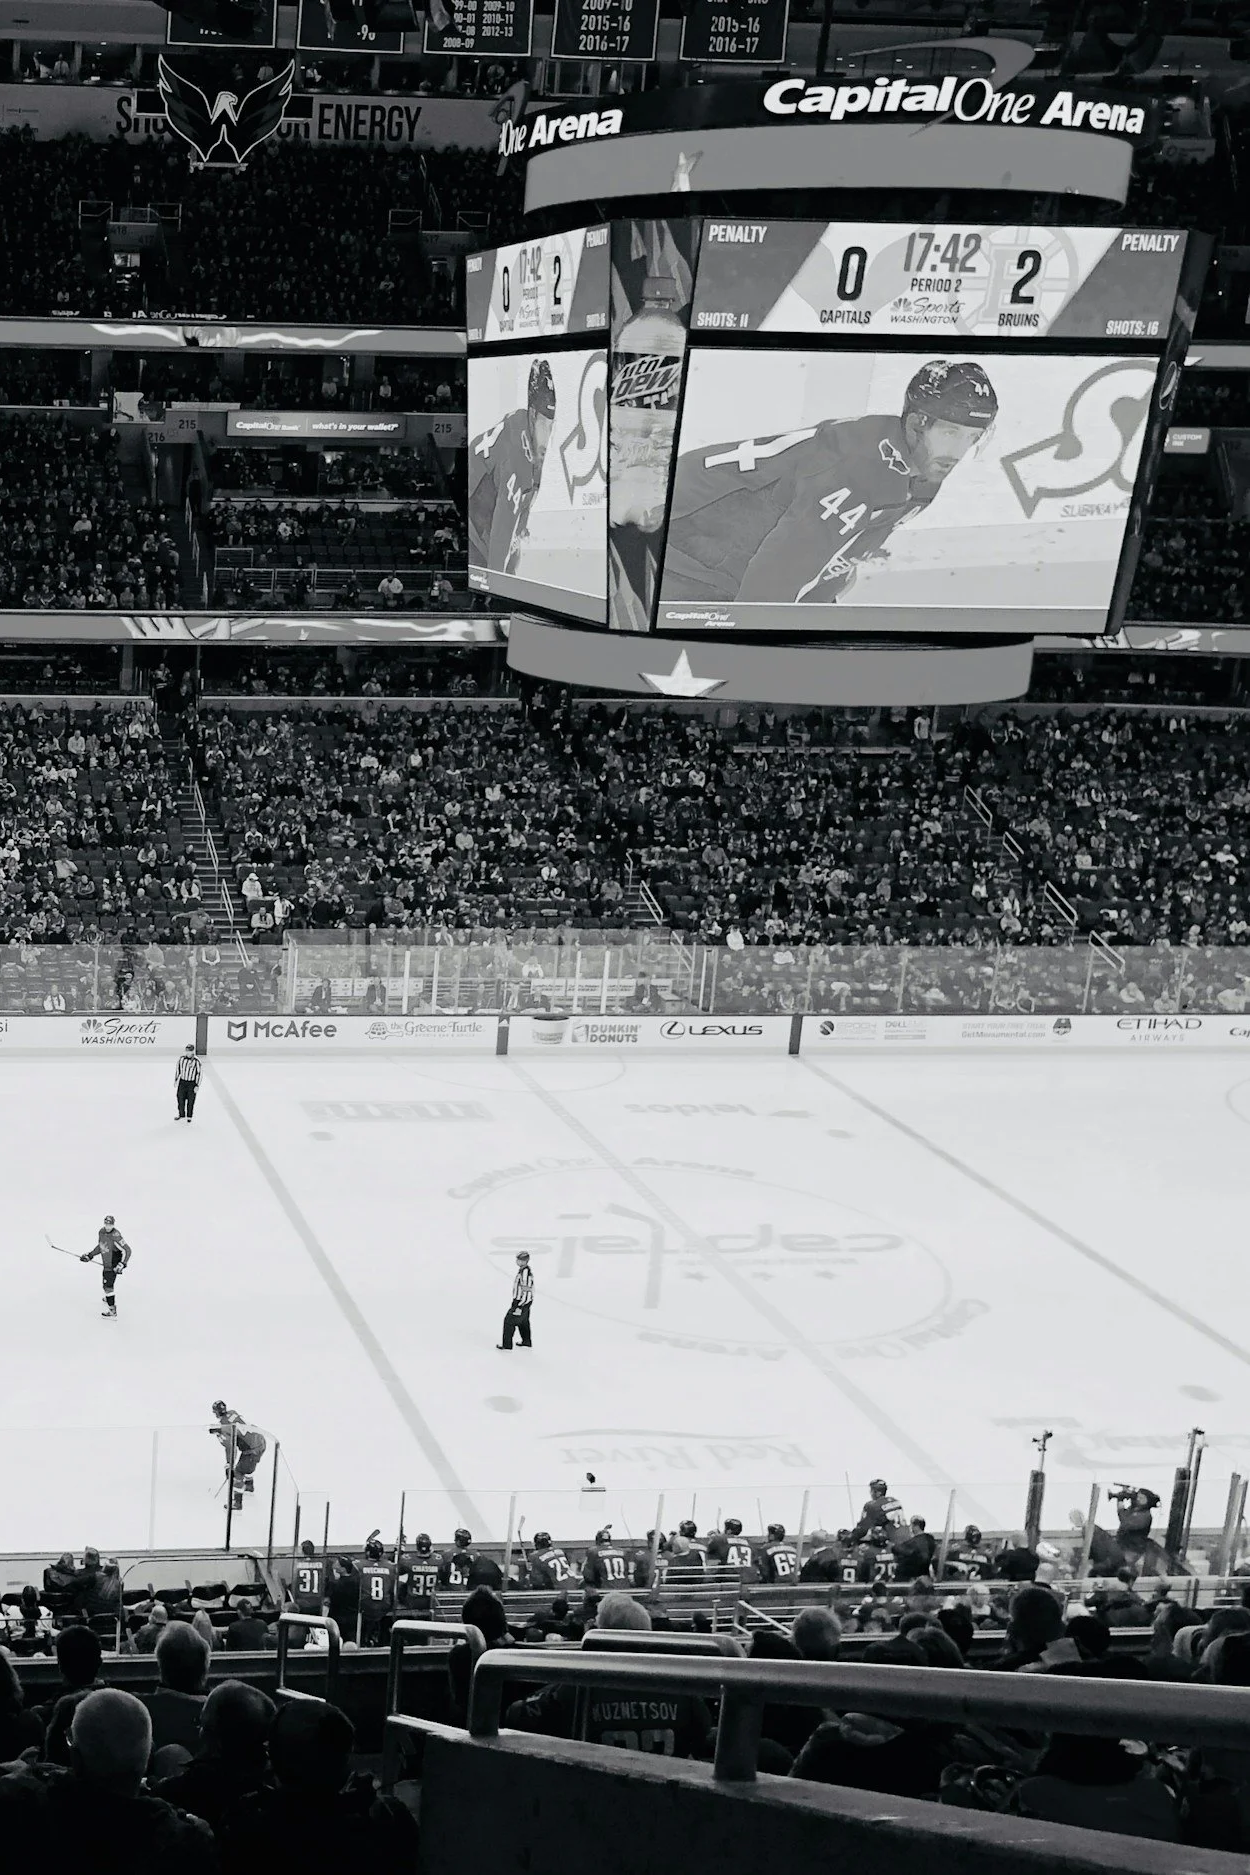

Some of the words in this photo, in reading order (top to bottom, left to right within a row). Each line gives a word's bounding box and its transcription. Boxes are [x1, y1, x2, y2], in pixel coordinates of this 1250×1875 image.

[482, 12, 513, 25] 2010-11
[581, 15, 631, 32] 2015-16
[711, 16, 760, 33] 2015-16
[482, 25, 513, 37] 2012-13
[579, 35, 630, 52] 2016-17
[708, 36, 759, 53] 2016-17
[1040, 91, 1145, 133] Arena
[318, 103, 423, 142] ENERGY
[528, 108, 624, 148] Arena
[708, 224, 768, 243] PENALTY
[1121, 233, 1180, 252] PENALTY
[903, 232, 982, 273] 17:42
[519, 245, 542, 284] 17:42
[553, 255, 562, 305] 2
[836, 246, 868, 302] 0
[1010, 249, 1042, 304] 2
[502, 266, 510, 313] 0
[910, 277, 952, 293] PERIOD
[954, 279, 963, 293] 2
[913, 297, 965, 314] Sports
[697, 312, 737, 328] SHOTS:
[819, 309, 872, 324] CAPITALS
[998, 313, 1040, 327] BRUINS
[1105, 320, 1146, 335] SHOTS:
[1146, 321, 1160, 336] 16
[974, 381, 991, 397] 44
[178, 419, 197, 430] 215
[312, 422, 338, 430] what's
[348, 424, 367, 433] your
[434, 423, 452, 433] 215
[148, 431, 166, 442] 216
[1172, 433, 1202, 441] CUSTOM
[506, 473, 522, 515] 44
[819, 487, 868, 536] 44
[104, 1018, 162, 1036] Sports
[253, 1020, 338, 1038] McAfee
[404, 1021, 447, 1036] Greene
[448, 1021, 484, 1033] Turtle
[590, 1024, 642, 1033] DUNKIN'
[688, 1025, 763, 1036] LEXUS
[1116, 1018, 1203, 1030] ETIHAD
[589, 1033, 638, 1043] DONUTS
[1129, 1034, 1185, 1042] AIRWAYS
[634, 1156, 756, 1178] Arena
[636, 1331, 787, 1362] Arena
[560, 1442, 698, 1467] River
[704, 1441, 816, 1468] Red
[726, 1545, 752, 1567] 43
[603, 1557, 626, 1581] 10
[299, 1569, 319, 1593] 31
[371, 1576, 384, 1600] 8
[412, 1574, 437, 1596] 39
[591, 1701, 678, 1723] KUZNETSOV
